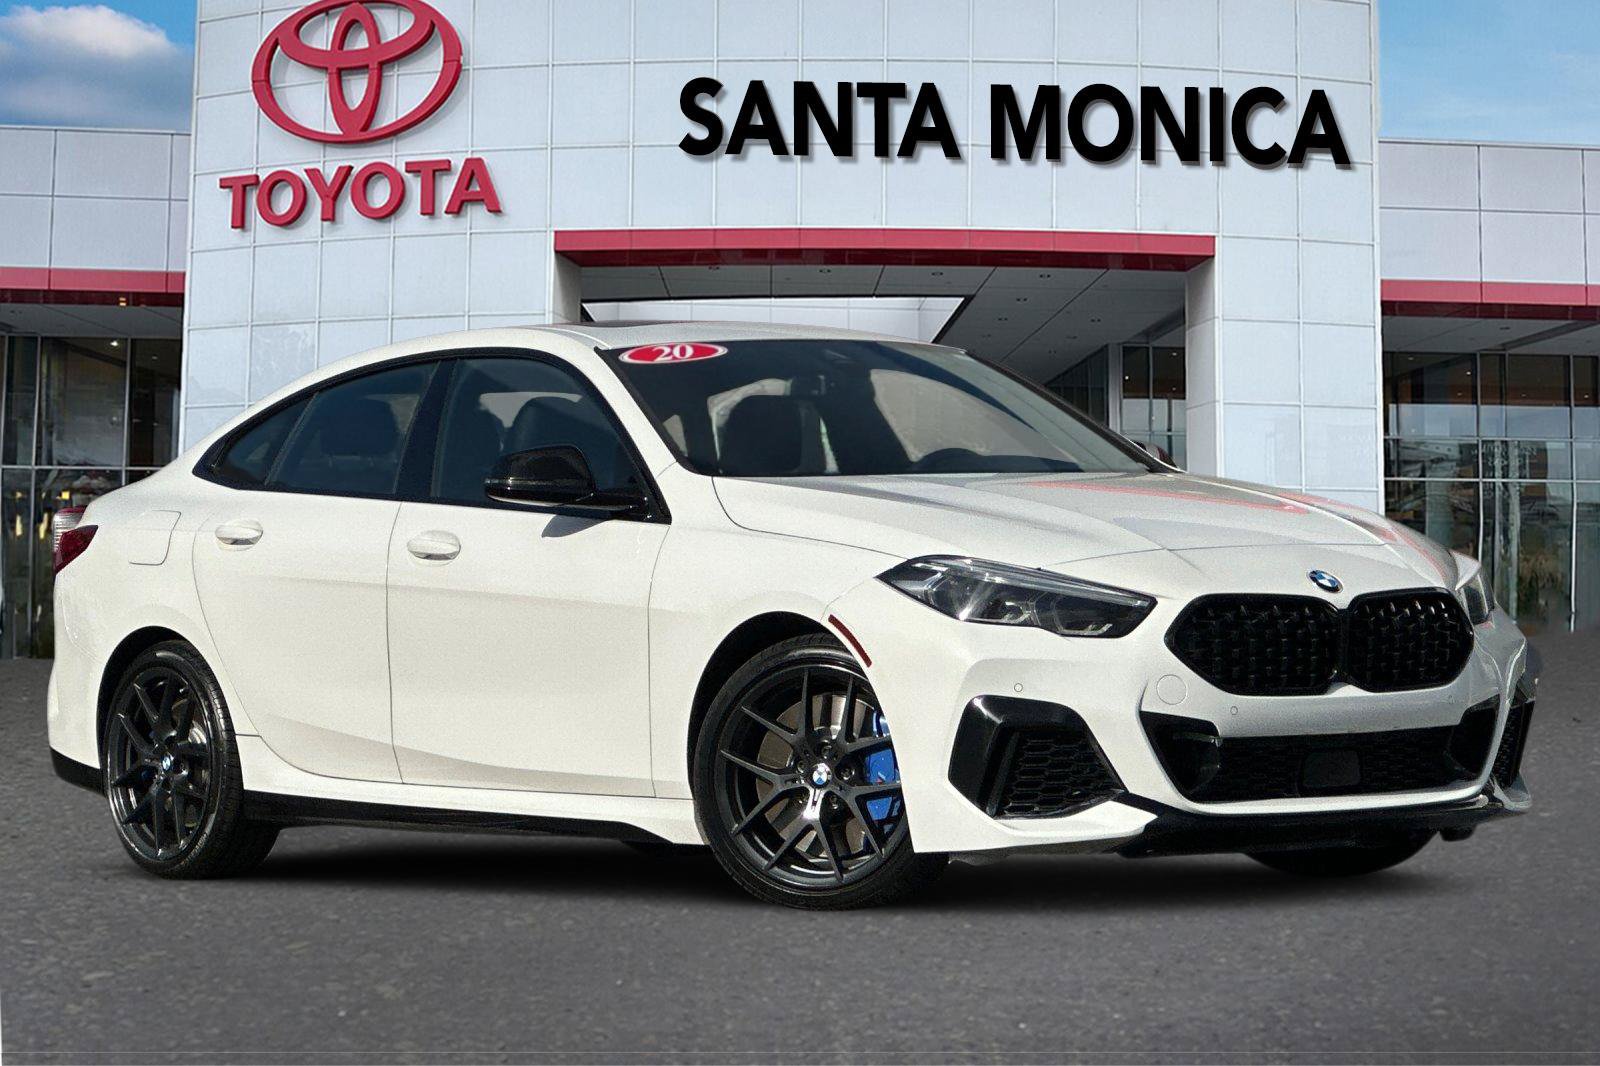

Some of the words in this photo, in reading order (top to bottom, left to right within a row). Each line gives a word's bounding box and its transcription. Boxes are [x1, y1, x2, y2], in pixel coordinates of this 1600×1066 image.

[679, 77, 961, 160] SANTA
[990, 83, 1351, 169] MONICA
[219, 156, 502, 229] TOYOTA
[652, 343, 694, 362] 20
